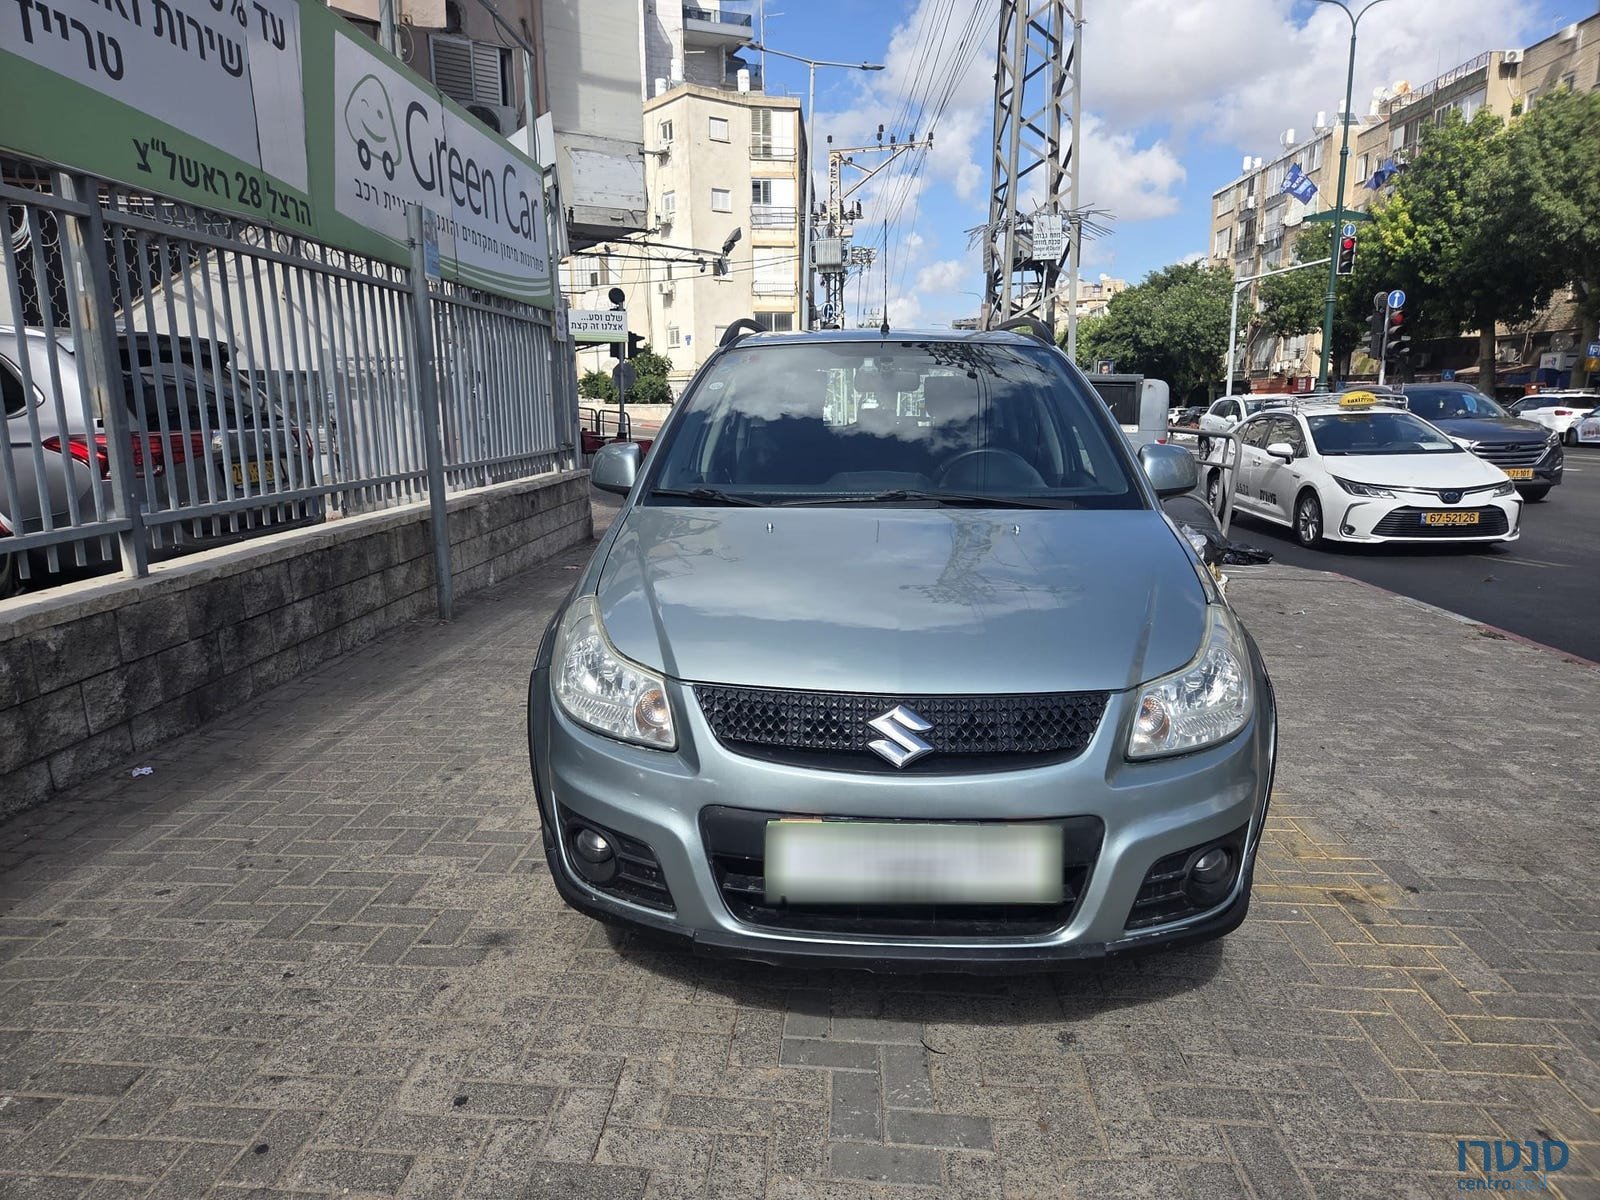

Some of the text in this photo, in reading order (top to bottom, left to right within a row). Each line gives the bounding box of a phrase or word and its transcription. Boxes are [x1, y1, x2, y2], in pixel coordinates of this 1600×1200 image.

[15, 0, 125, 81] טרייד
[152, 0, 244, 78] שירות
[253, 1, 286, 51] עד
[405, 100, 538, 244] Green Car
[235, 170, 262, 209] 28
[265, 180, 312, 227] הרצל
[353, 178, 380, 206] רכב
[462, 225, 499, 254] מתקדמים
[500, 242, 519, 262] מימון
[570, 321, 588, 331] קצת
[602, 322, 624, 331] אצלנו
[605, 313, 623, 322] שלם
